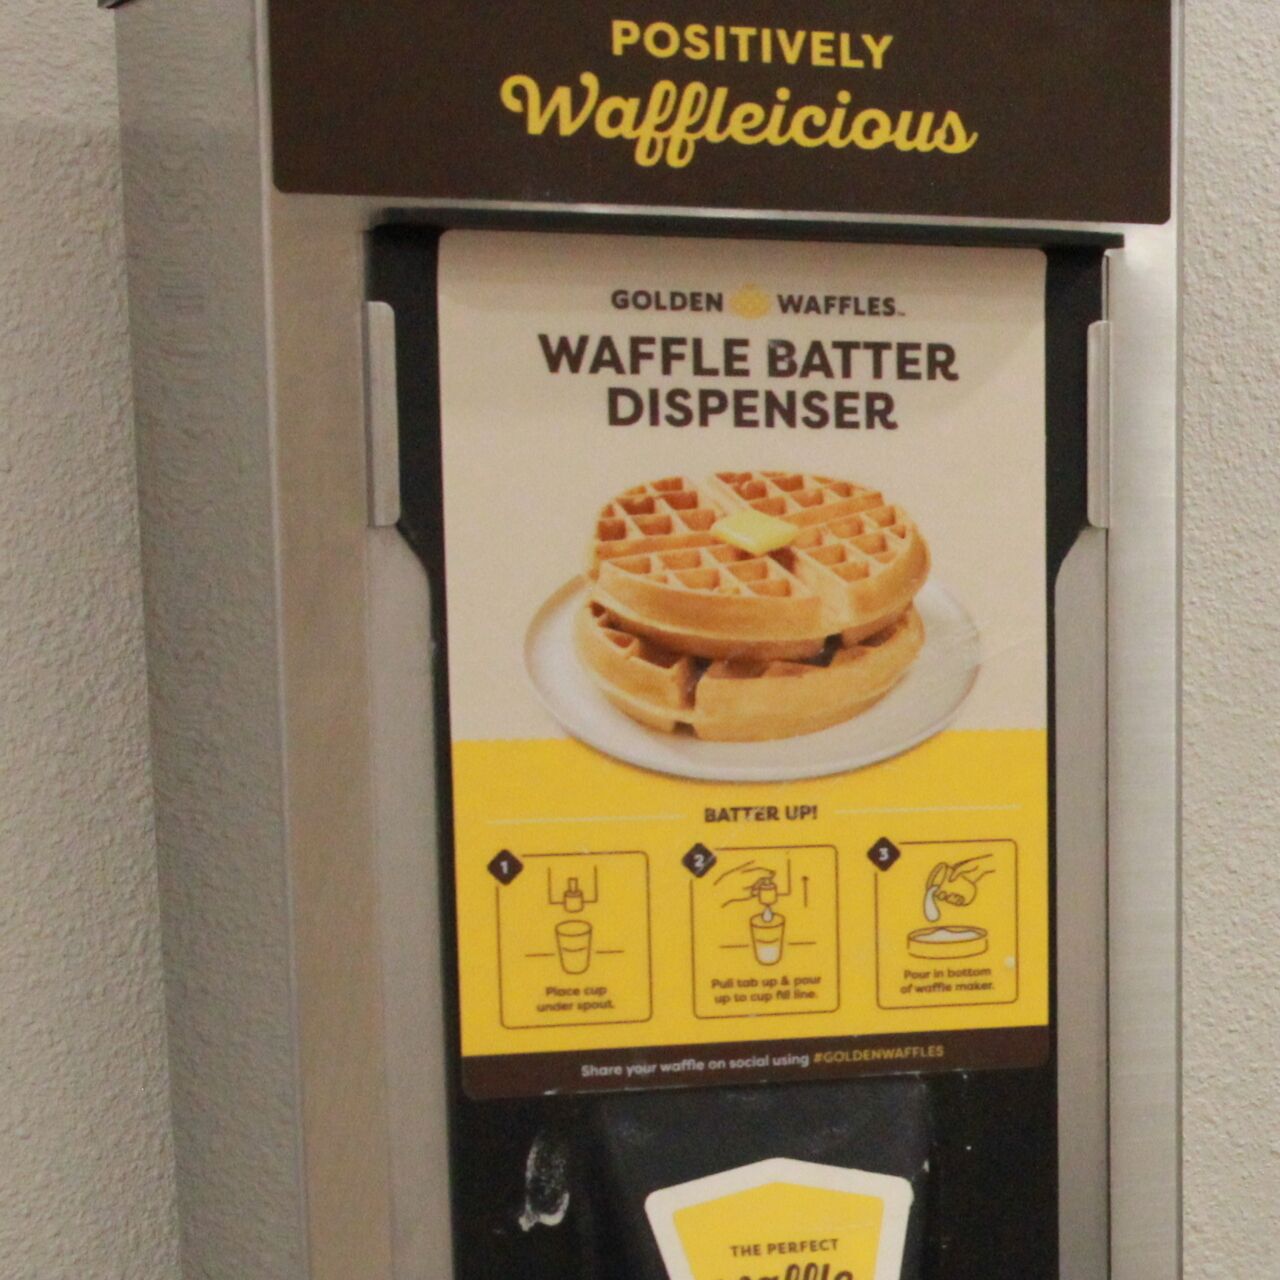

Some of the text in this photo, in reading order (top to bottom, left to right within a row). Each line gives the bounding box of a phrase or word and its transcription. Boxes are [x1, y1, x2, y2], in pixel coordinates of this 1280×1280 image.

[610, 19, 894, 71] POSITIVELY
[500, 71, 979, 169] Waffleicious
[610, 289, 896, 318] GOLDEN WAFFLES
[537, 332, 961, 383] WAFFLE BATTER
[607, 386, 899, 431] DISPENSER
[704, 805, 818, 823] BATTER UP!
[693, 855, 705, 868] 2
[879, 848, 889, 861] 3
[501, 860, 509, 873] 1
[904, 966, 992, 980] Pour in bottom
[545, 985, 607, 1000] Place cup
[711, 975, 822, 992] Pull tab up & pour
[900, 980, 994, 994] of waffle maker.
[714, 987, 818, 1006] up to cup fill line.
[536, 999, 615, 1014] under spout.
[581, 1044, 945, 1078] Share your waffle on social using #GOLDENWAFFLES
[729, 1237, 841, 1258] THE PERFECT
